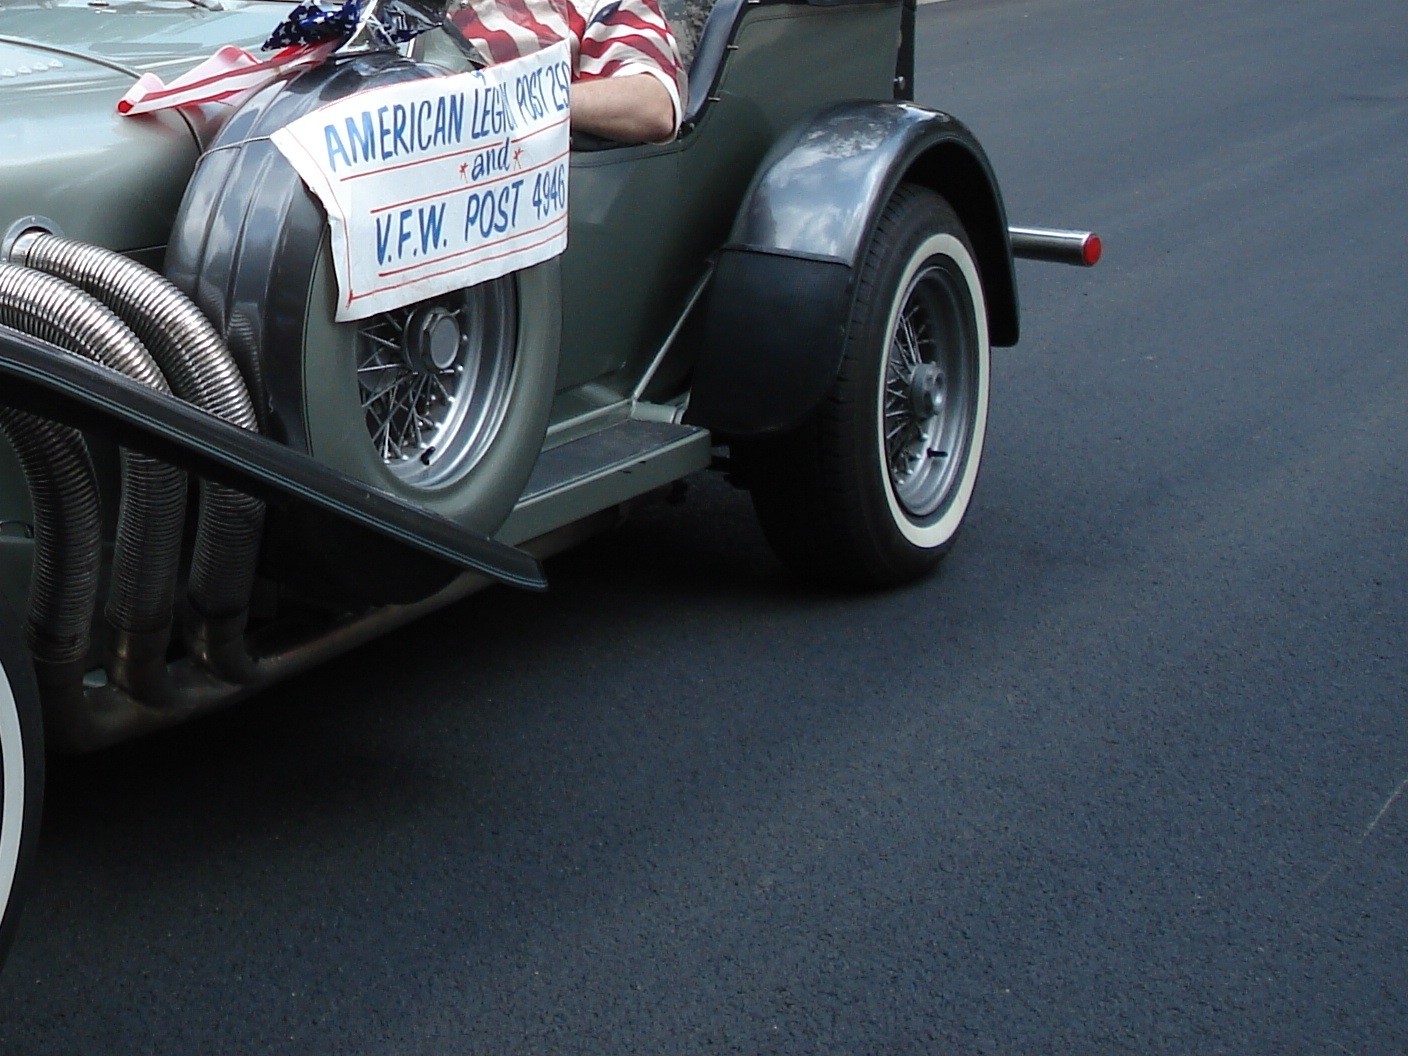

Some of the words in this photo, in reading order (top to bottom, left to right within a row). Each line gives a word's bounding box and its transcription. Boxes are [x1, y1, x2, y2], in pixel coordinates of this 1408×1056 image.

[324, 93, 464, 173] AMERICAN
[516, 67, 550, 126] POST
[471, 136, 511, 181] and
[375, 202, 448, 266] V.F.W.
[464, 178, 525, 242] POST
[532, 163, 566, 220] 4946
